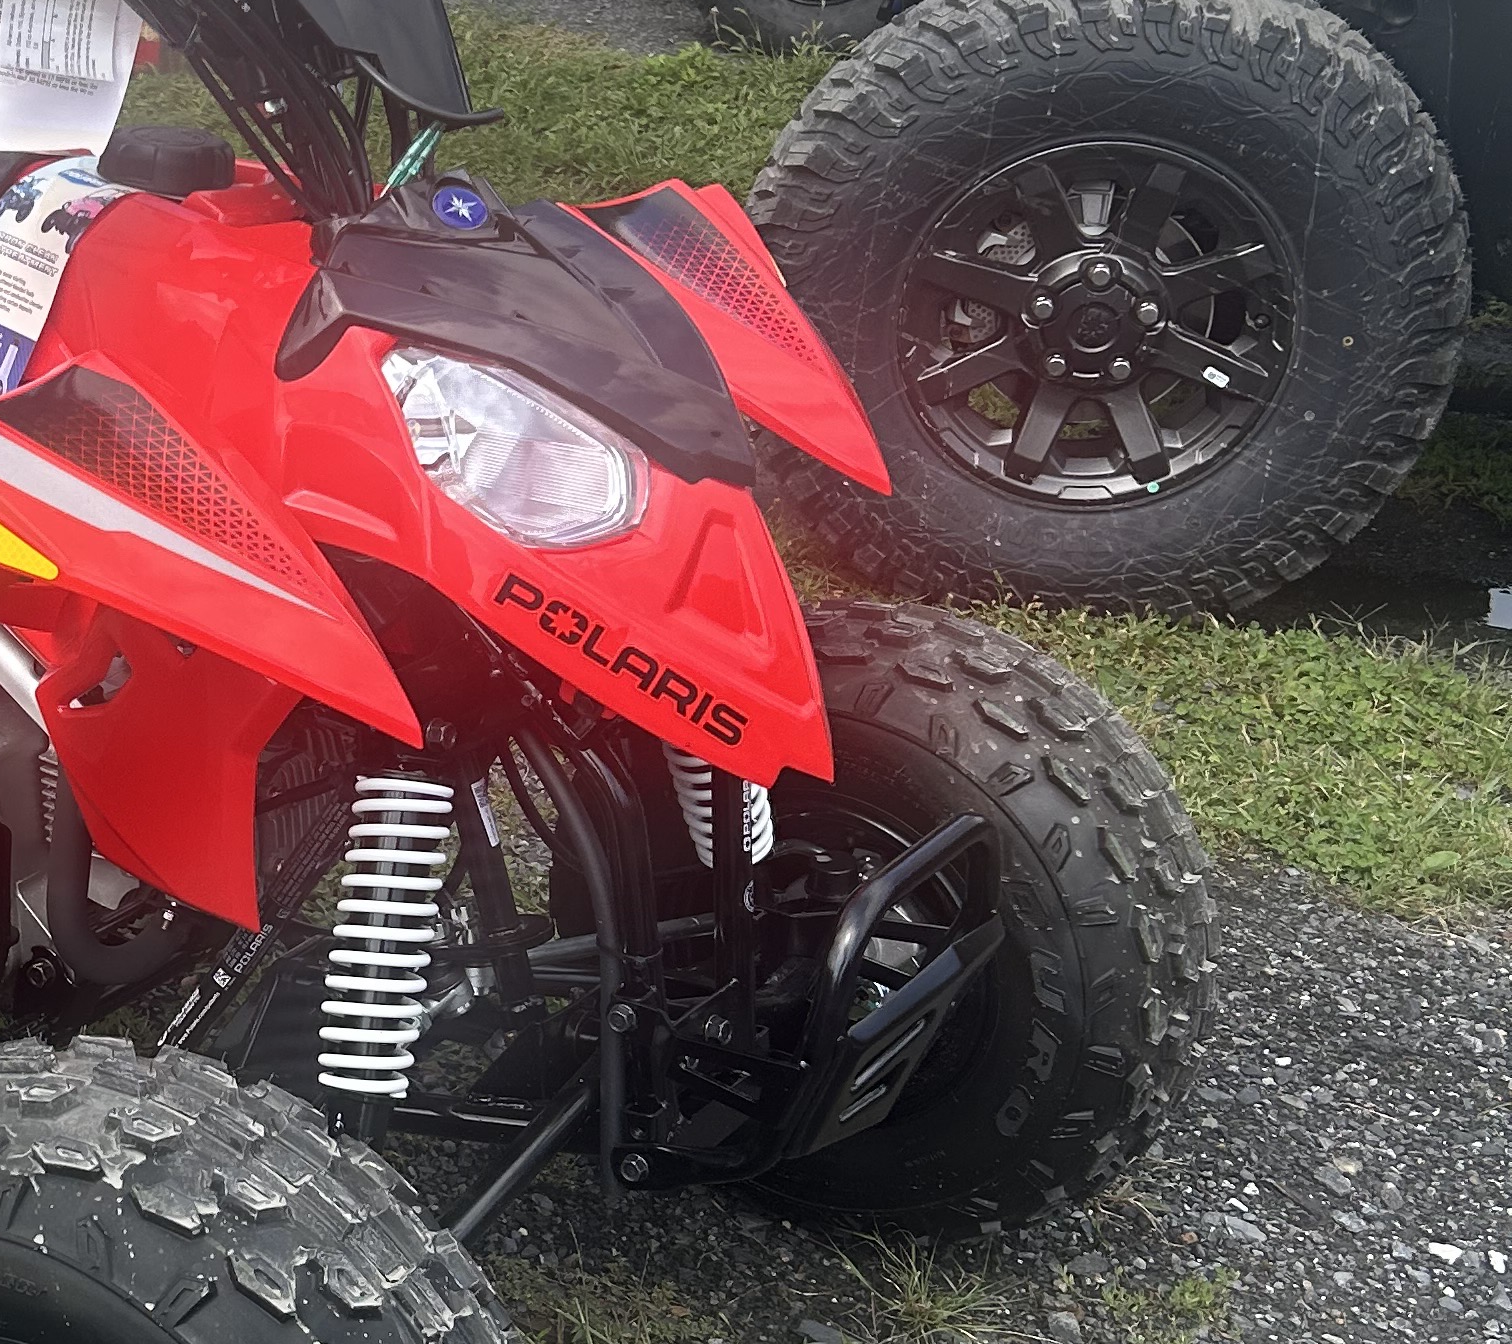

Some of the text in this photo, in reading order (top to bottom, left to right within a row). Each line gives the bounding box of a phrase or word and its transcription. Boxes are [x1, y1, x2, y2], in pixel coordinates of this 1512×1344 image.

[0, 245, 59, 278] TREATMENT
[26, 244, 59, 265] CLEAN
[494, 572, 750, 747] POLARIS
[233, 923, 274, 974] POLARIS
